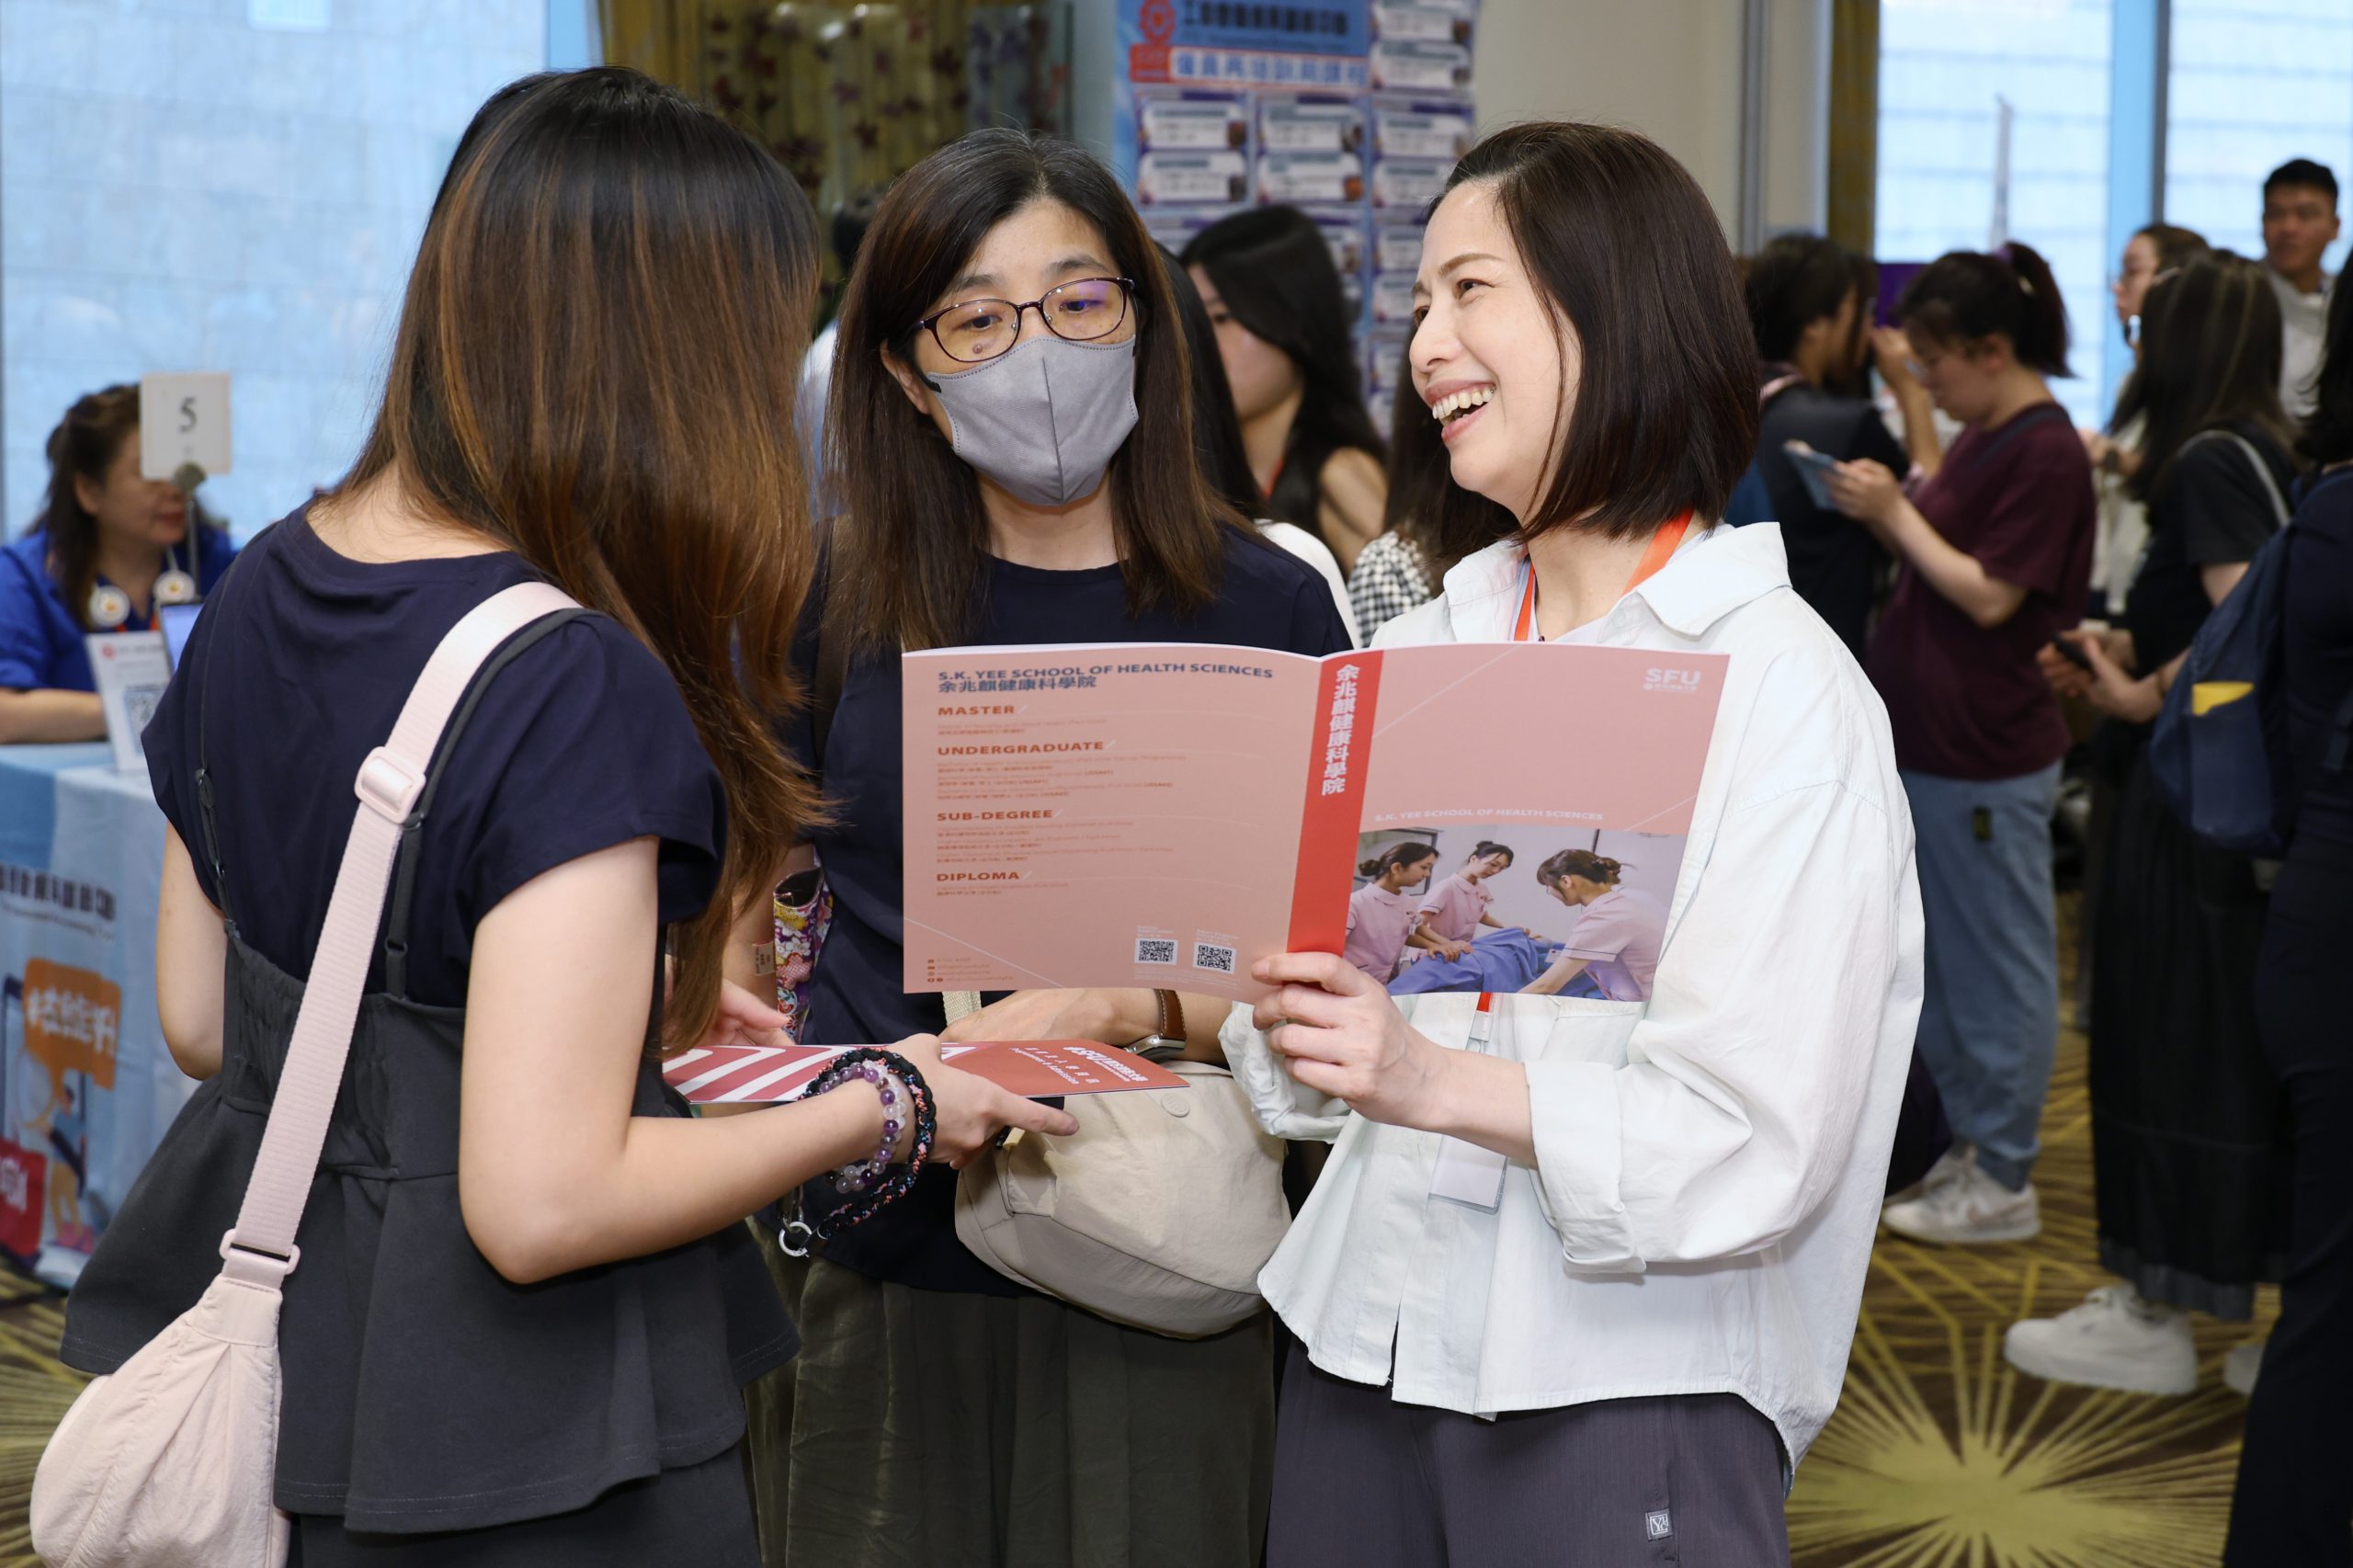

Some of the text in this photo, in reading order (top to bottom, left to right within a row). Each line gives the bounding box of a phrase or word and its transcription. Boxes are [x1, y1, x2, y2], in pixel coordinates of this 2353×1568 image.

[178, 396, 198, 435] 5
[938, 663, 1273, 681] S.K. YEE SCHOOL OF HEALTH SCIENCES
[1644, 667, 1702, 686] SFU
[938, 705, 1015, 716] MASTER
[938, 741, 1104, 756] UNDERGRADUATE
[937, 810, 1052, 822] SUB-DEGREE
[1400, 811, 1422, 819] YEE
[1424, 809, 1473, 818] SCHOOL
[1476, 808, 1494, 817] OF
[1495, 809, 1543, 817] HEALTH
[1544, 810, 1604, 821] SCIENCES
[937, 871, 1019, 881] DIPLOMA
